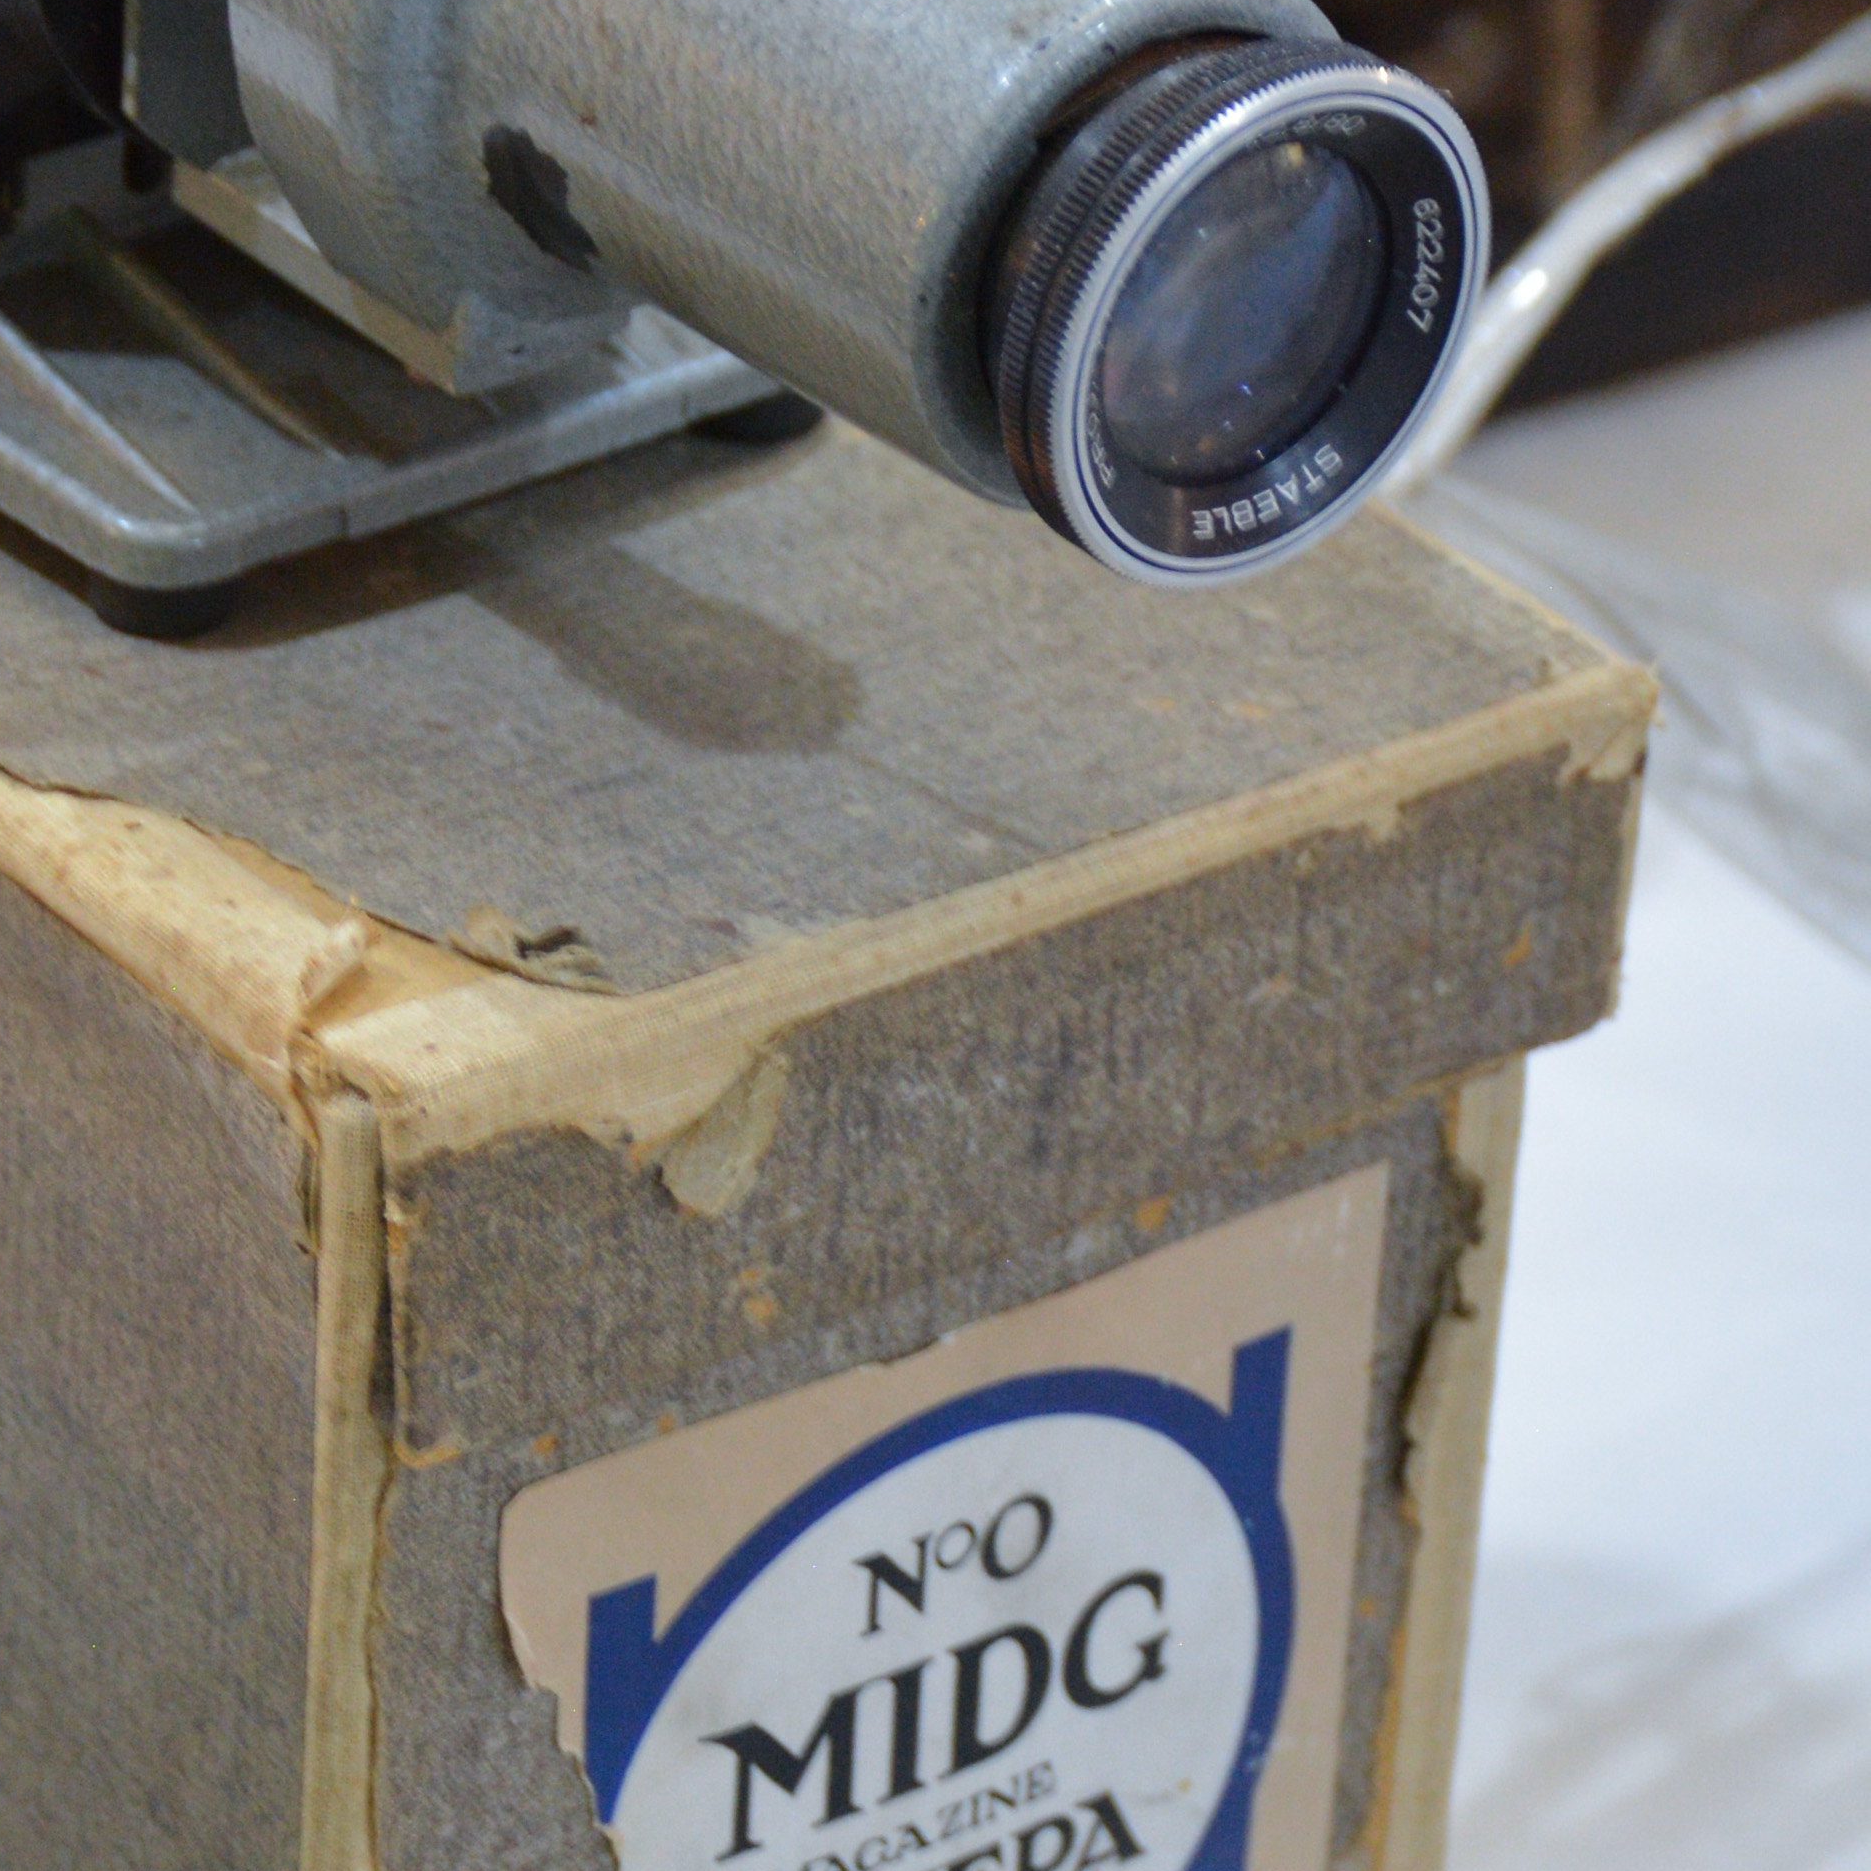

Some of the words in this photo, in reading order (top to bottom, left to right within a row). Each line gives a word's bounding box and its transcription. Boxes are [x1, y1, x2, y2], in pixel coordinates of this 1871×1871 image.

[1407, 197, 1445, 334] 622407
[1191, 442, 1344, 542] STAEBLE
[697, 1568, 1171, 1864] MIDG
